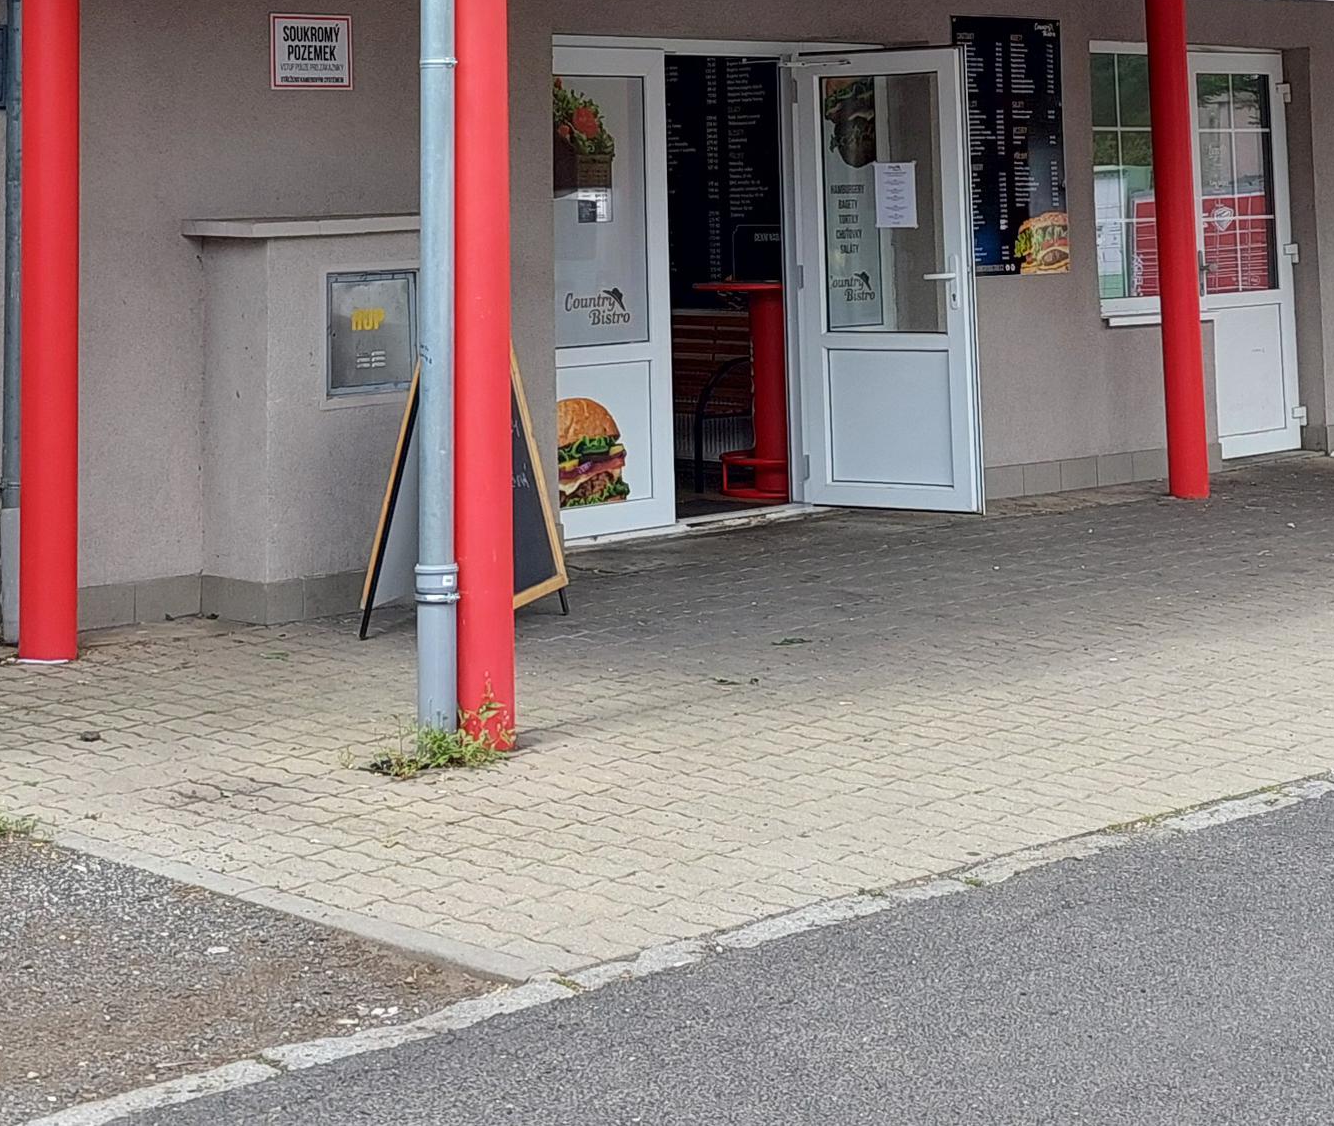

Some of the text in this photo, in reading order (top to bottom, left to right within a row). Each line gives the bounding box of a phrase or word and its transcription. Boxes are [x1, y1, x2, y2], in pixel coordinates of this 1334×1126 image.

[283, 23, 341, 43] SOUKROMÝ
[287, 45, 337, 61] POZEMEK
[830, 275, 865, 292] ountry
[565, 292, 616, 312] Country
[844, 289, 876, 302] Bistro
[588, 309, 630, 326] Bistro
